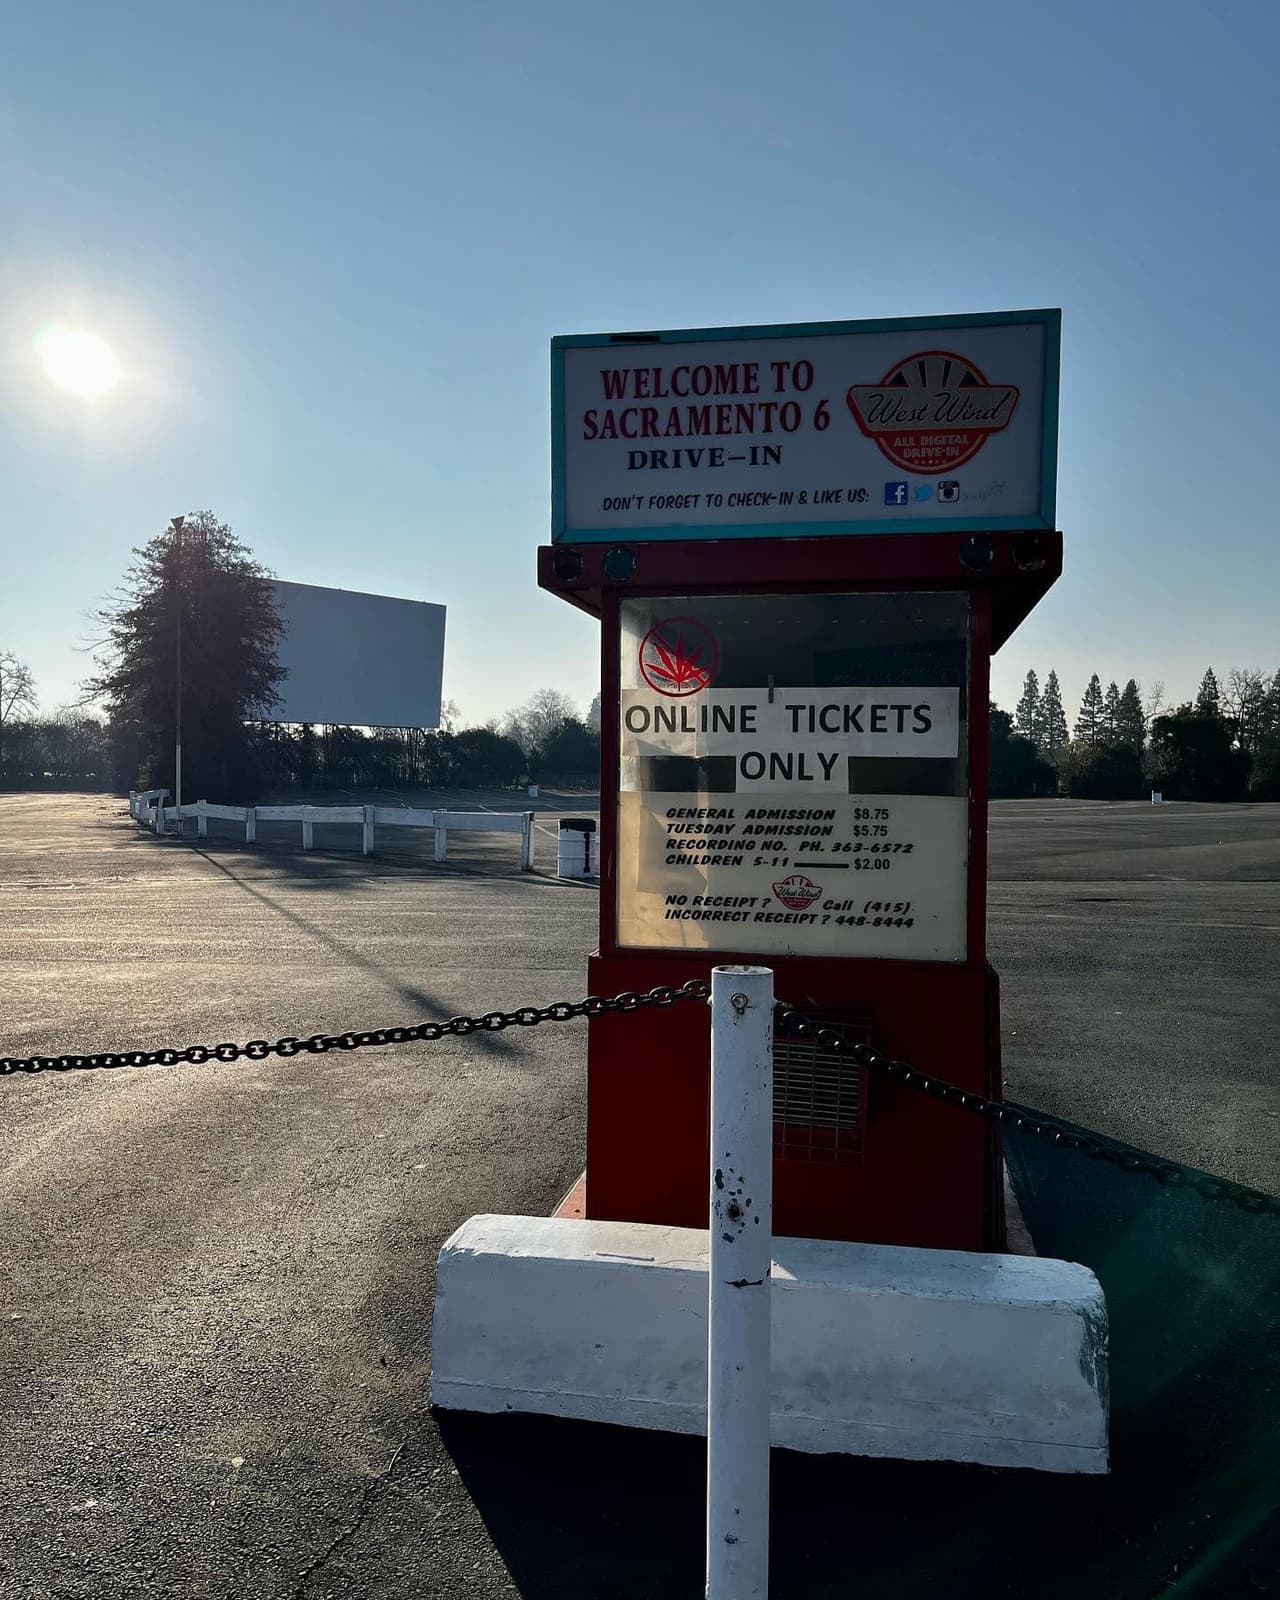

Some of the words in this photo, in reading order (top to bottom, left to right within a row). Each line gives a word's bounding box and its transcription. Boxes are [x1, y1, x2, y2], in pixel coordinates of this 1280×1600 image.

[600, 363, 760, 400] WELCOME
[771, 360, 814, 393] TO
[867, 393, 929, 424] West
[933, 390, 1012, 423] Wind
[583, 401, 801, 440] SACRAMENTO
[814, 400, 830, 431] 6
[894, 436, 916, 448] ALL
[921, 434, 970, 446] DIGITAL
[627, 445, 783, 470] DRIVE-IN
[602, 494, 643, 511] DON'T
[648, 493, 700, 509] FORGET
[705, 493, 723, 507] TO
[727, 491, 793, 507] CHECK-IN
[798, 490, 808, 504] &
[814, 489, 842, 504] LIKE
[847, 487, 870, 503] US:
[625, 704, 757, 734] ONLINE
[785, 704, 932, 734] TICKETS
[740, 751, 839, 781] ONLY
[666, 808, 736, 819] GENERAL
[744, 809, 836, 820] ADMISSION
[854, 808, 889, 820] $8.75
[666, 823, 736, 835] TUESDAY
[742, 825, 833, 836] ADMISSION
[853, 824, 888, 837] $5.75
[665, 839, 756, 851] RECORDING
[760, 840, 787, 852] NO.
[799, 841, 825, 852] PH.
[831, 842, 914, 854] 363-6572
[665, 855, 743, 866] CHILDREN
[753, 857, 789, 867] 5-11
[854, 858, 890, 870] $2.00
[665, 895, 688, 905] NO
[692, 896, 758, 908] RECEIPT
[822, 900, 853, 911] Call
[863, 901, 910, 915] (415)
[664, 909, 751, 922] INCORRECT
[753, 911, 818, 924] RECEIPT
[835, 915, 915, 928] 448-8444
